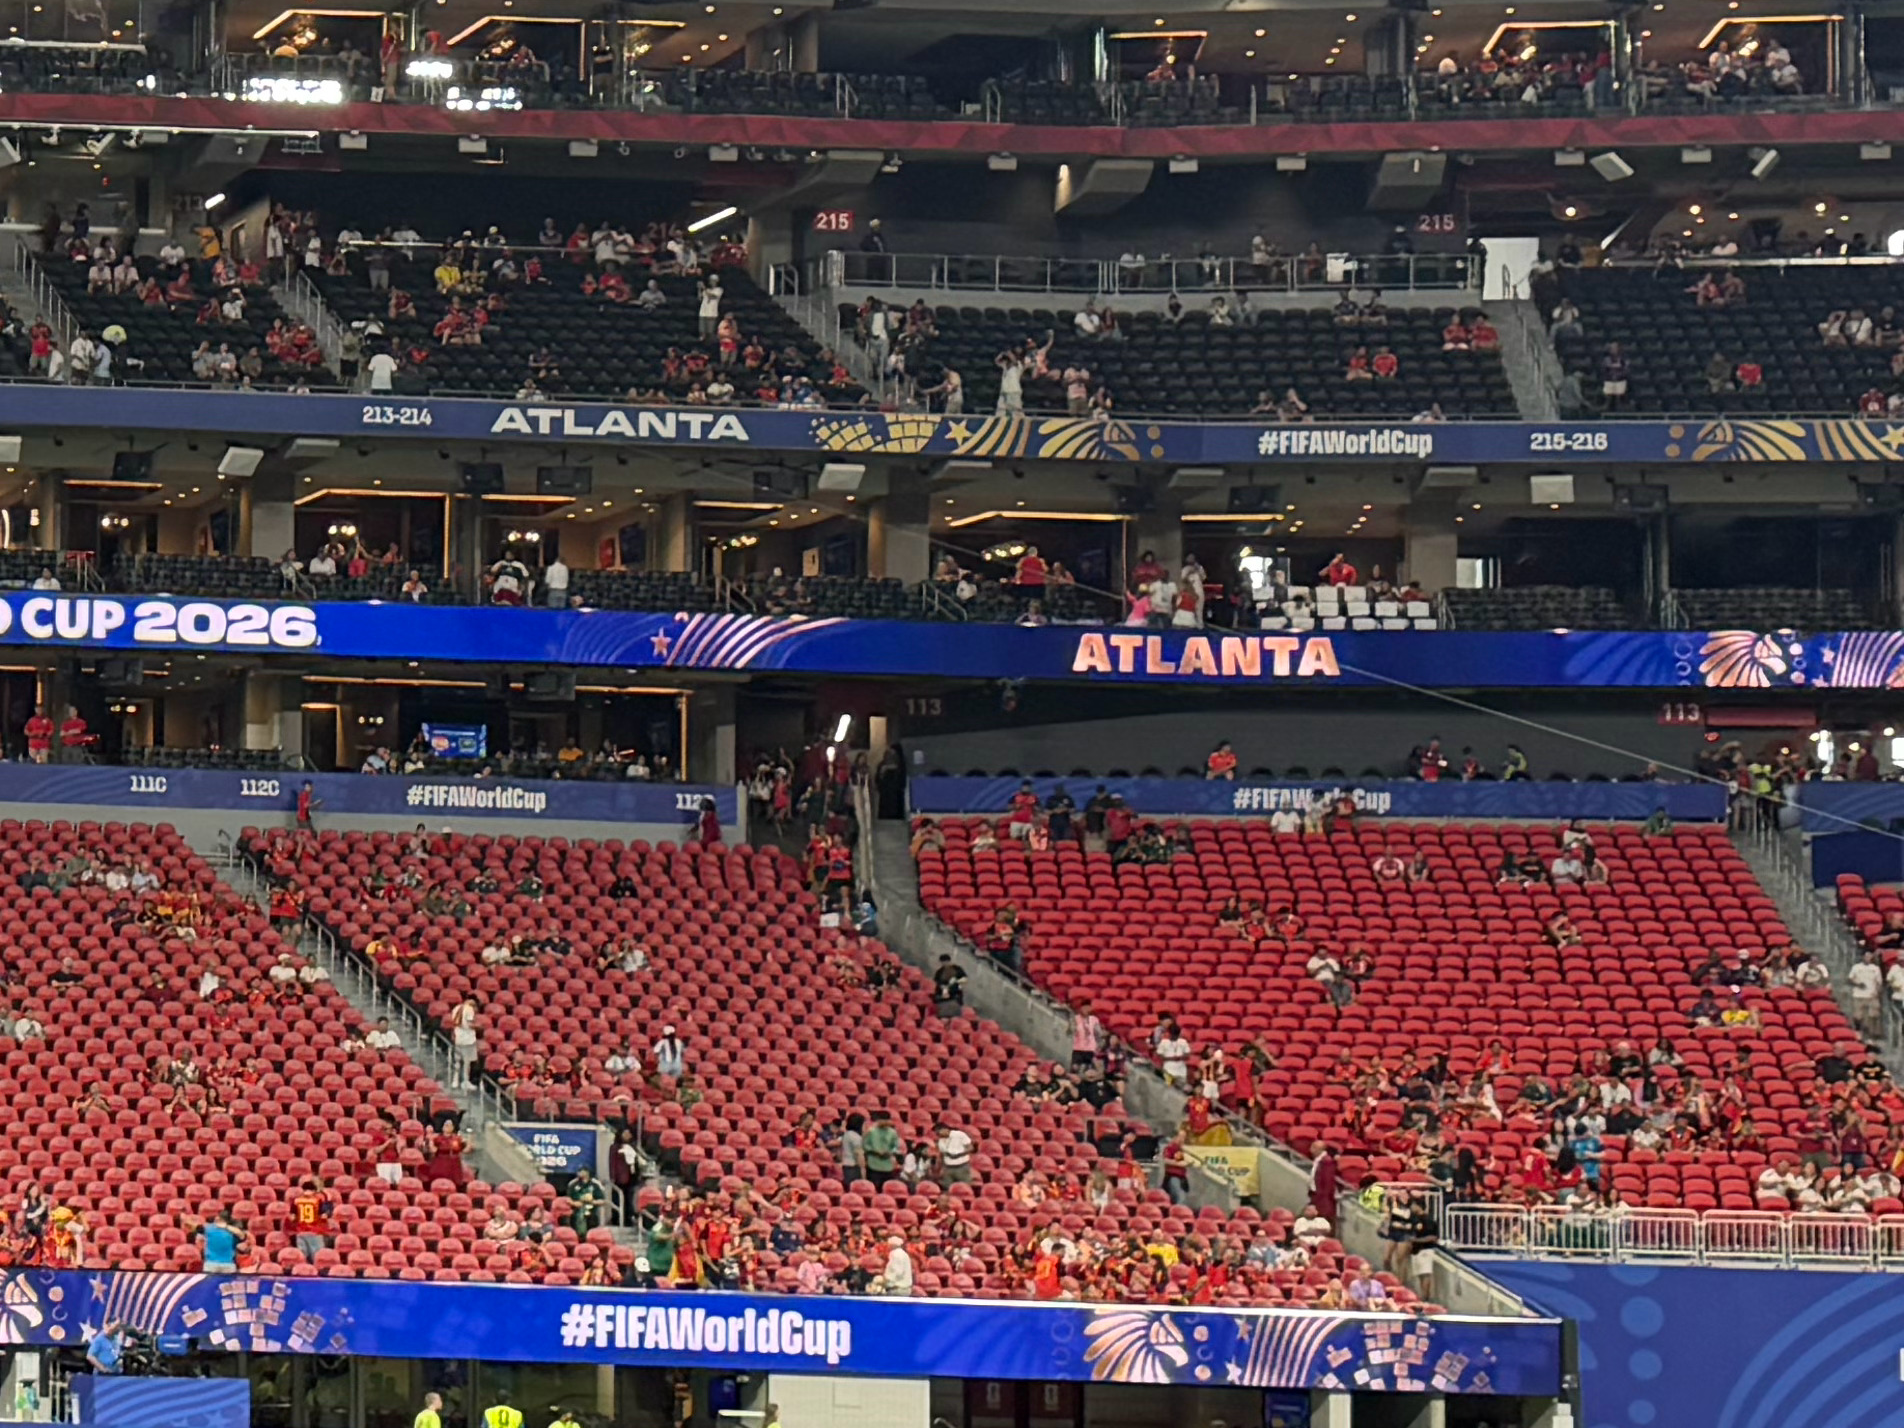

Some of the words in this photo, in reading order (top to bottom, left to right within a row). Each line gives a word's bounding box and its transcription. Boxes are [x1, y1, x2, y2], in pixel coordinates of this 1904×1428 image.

[817, 212, 849, 228] 215
[1419, 214, 1454, 230] 215
[363, 406, 431, 425] 213-214
[491, 407, 749, 440] ATLANTA
[1259, 429, 1432, 458] #FIFAWorldCup
[1531, 433, 1607, 450] 215-216
[21, 598, 125, 638] CUP
[134, 602, 316, 646] 2026
[1073, 633, 1340, 676] ATLANTA
[907, 699, 941, 715] 113
[1663, 704, 1700, 721] 113
[131, 776, 166, 792] 111C
[241, 780, 279, 796] 112C
[407, 785, 545, 812] #FIFAWorldCup
[534, 1134, 559, 1144] FIFA
[558, 1145, 581, 1155] CUP
[299, 1204, 314, 1222] 19
[561, 1304, 850, 1364] #FIFAWorldCup
